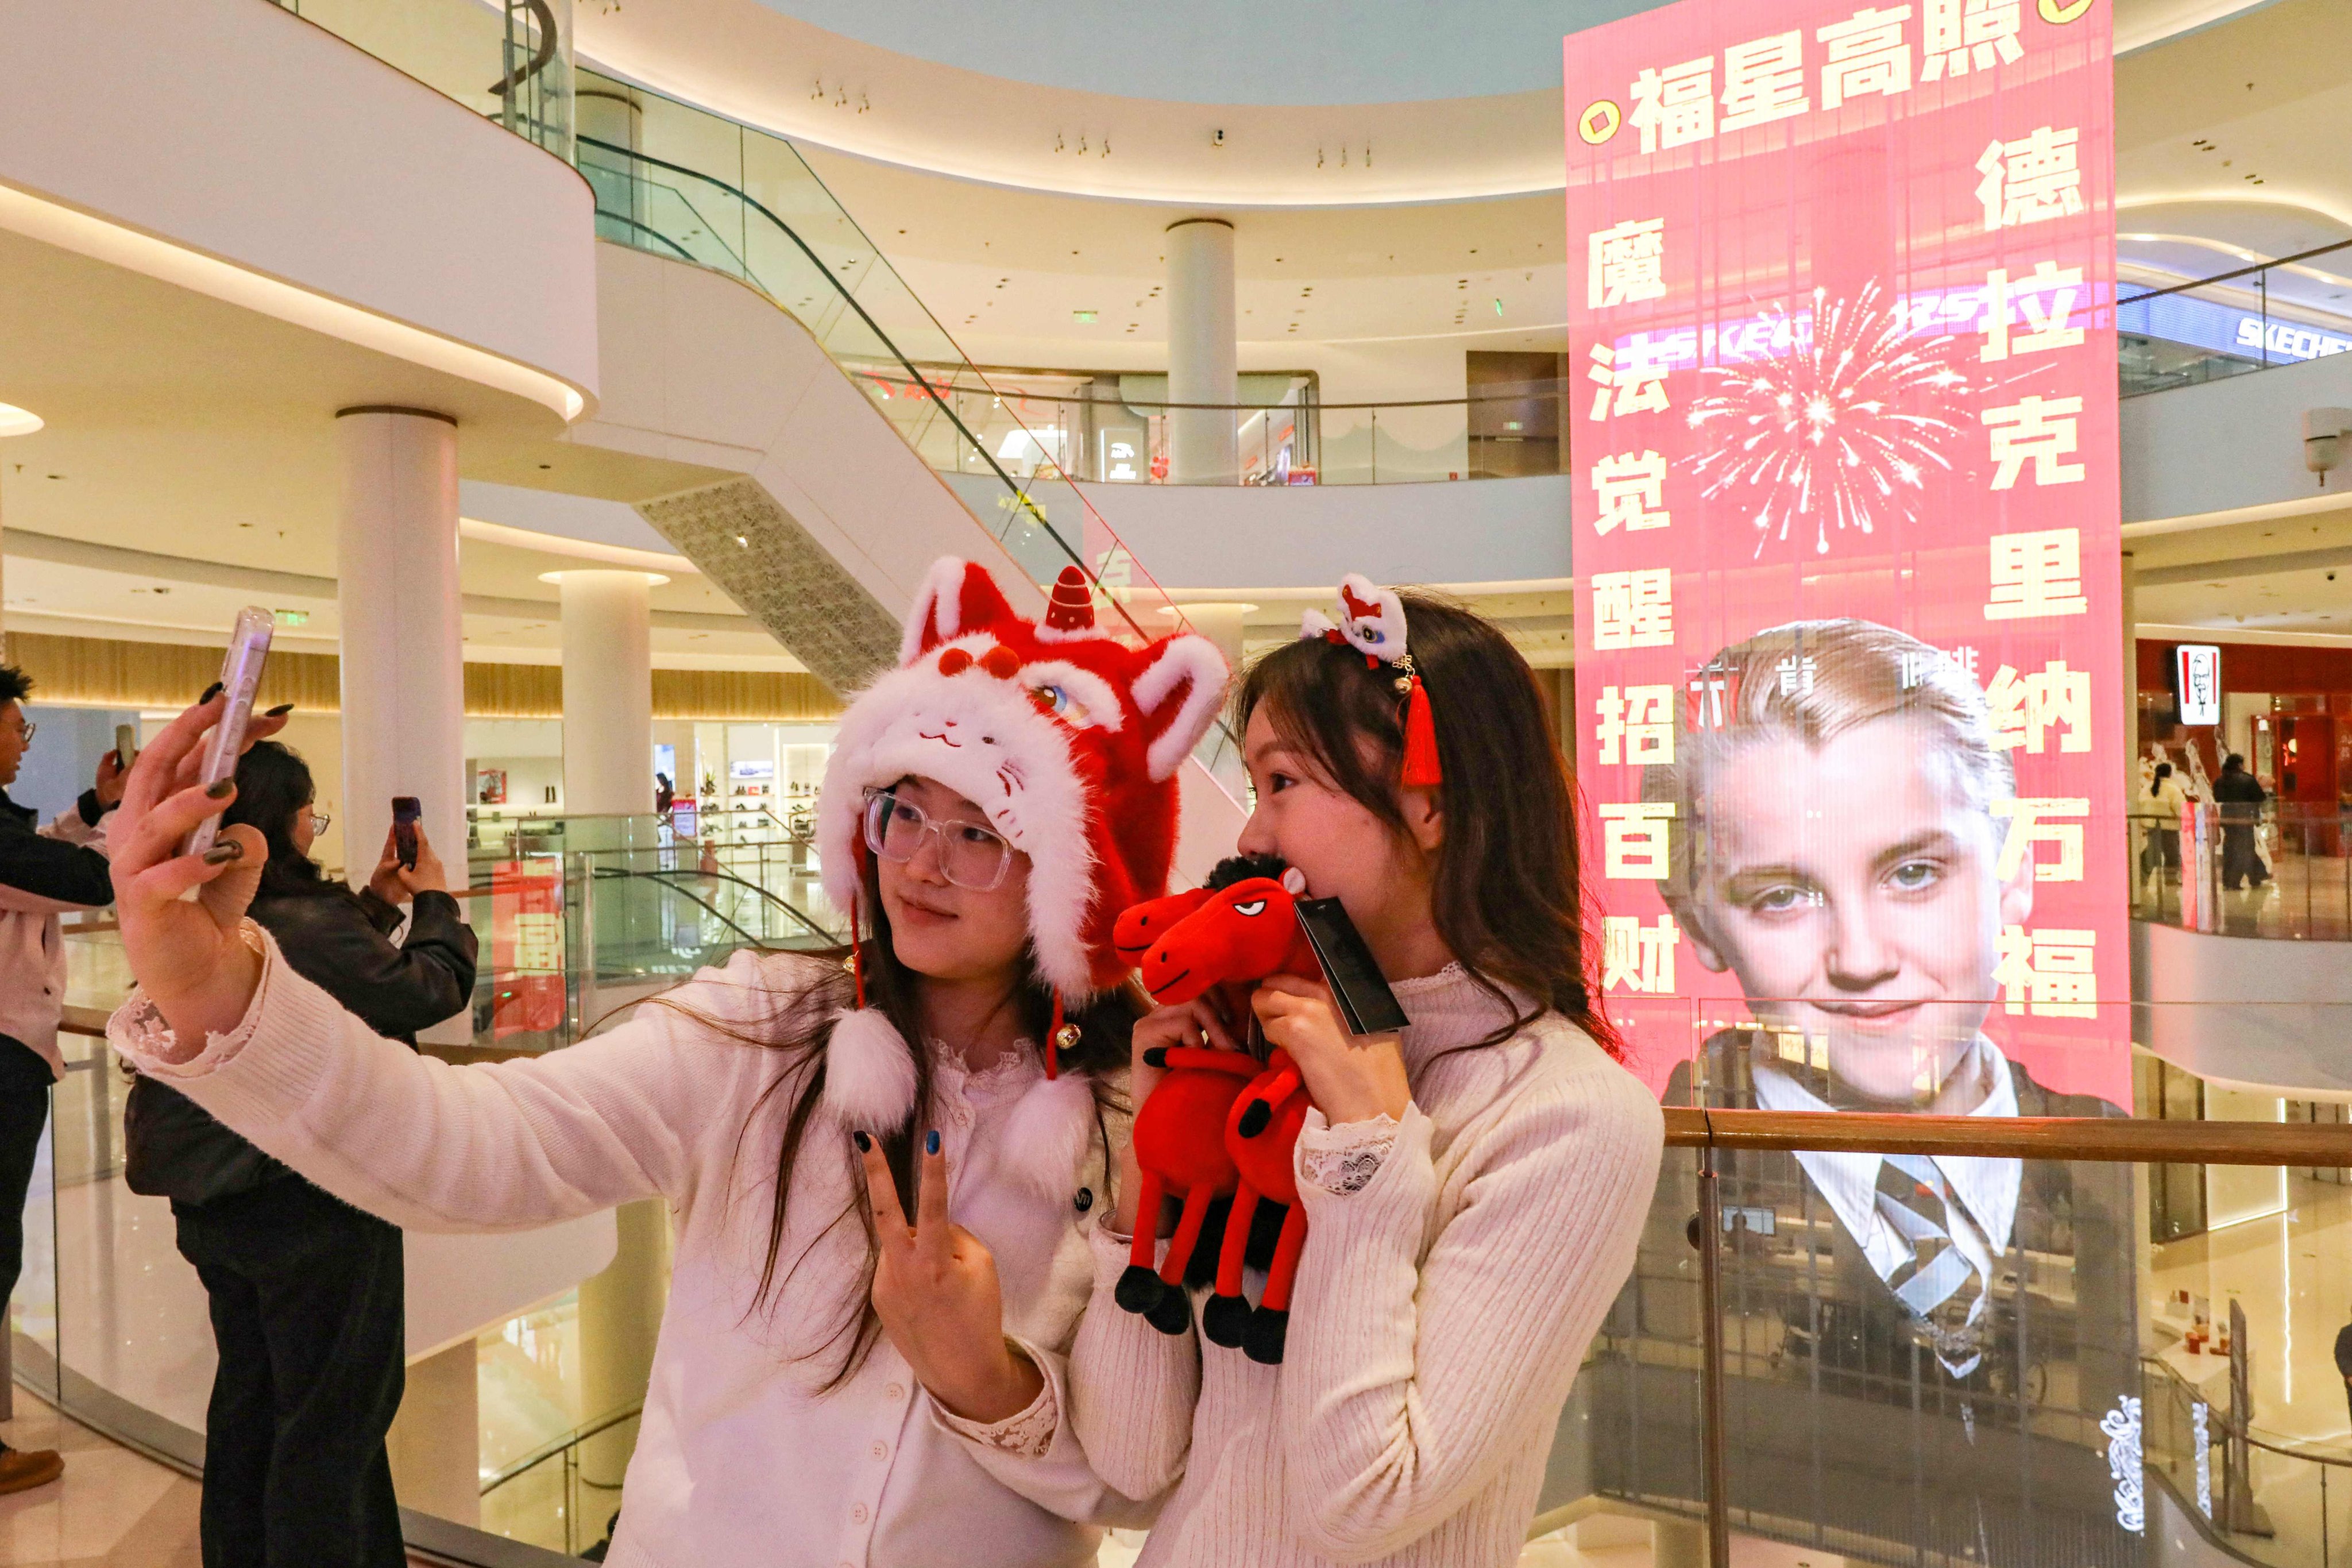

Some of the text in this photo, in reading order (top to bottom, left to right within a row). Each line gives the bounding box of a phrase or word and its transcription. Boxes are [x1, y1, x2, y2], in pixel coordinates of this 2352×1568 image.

[1628, 0, 2025, 155] 福星高照
[2236, 318, 2352, 360] SKECHE
[1587, 217, 1681, 995] 魔法觉醒招百财
[1973, 126, 2098, 1019] 德拉克里纳万福
